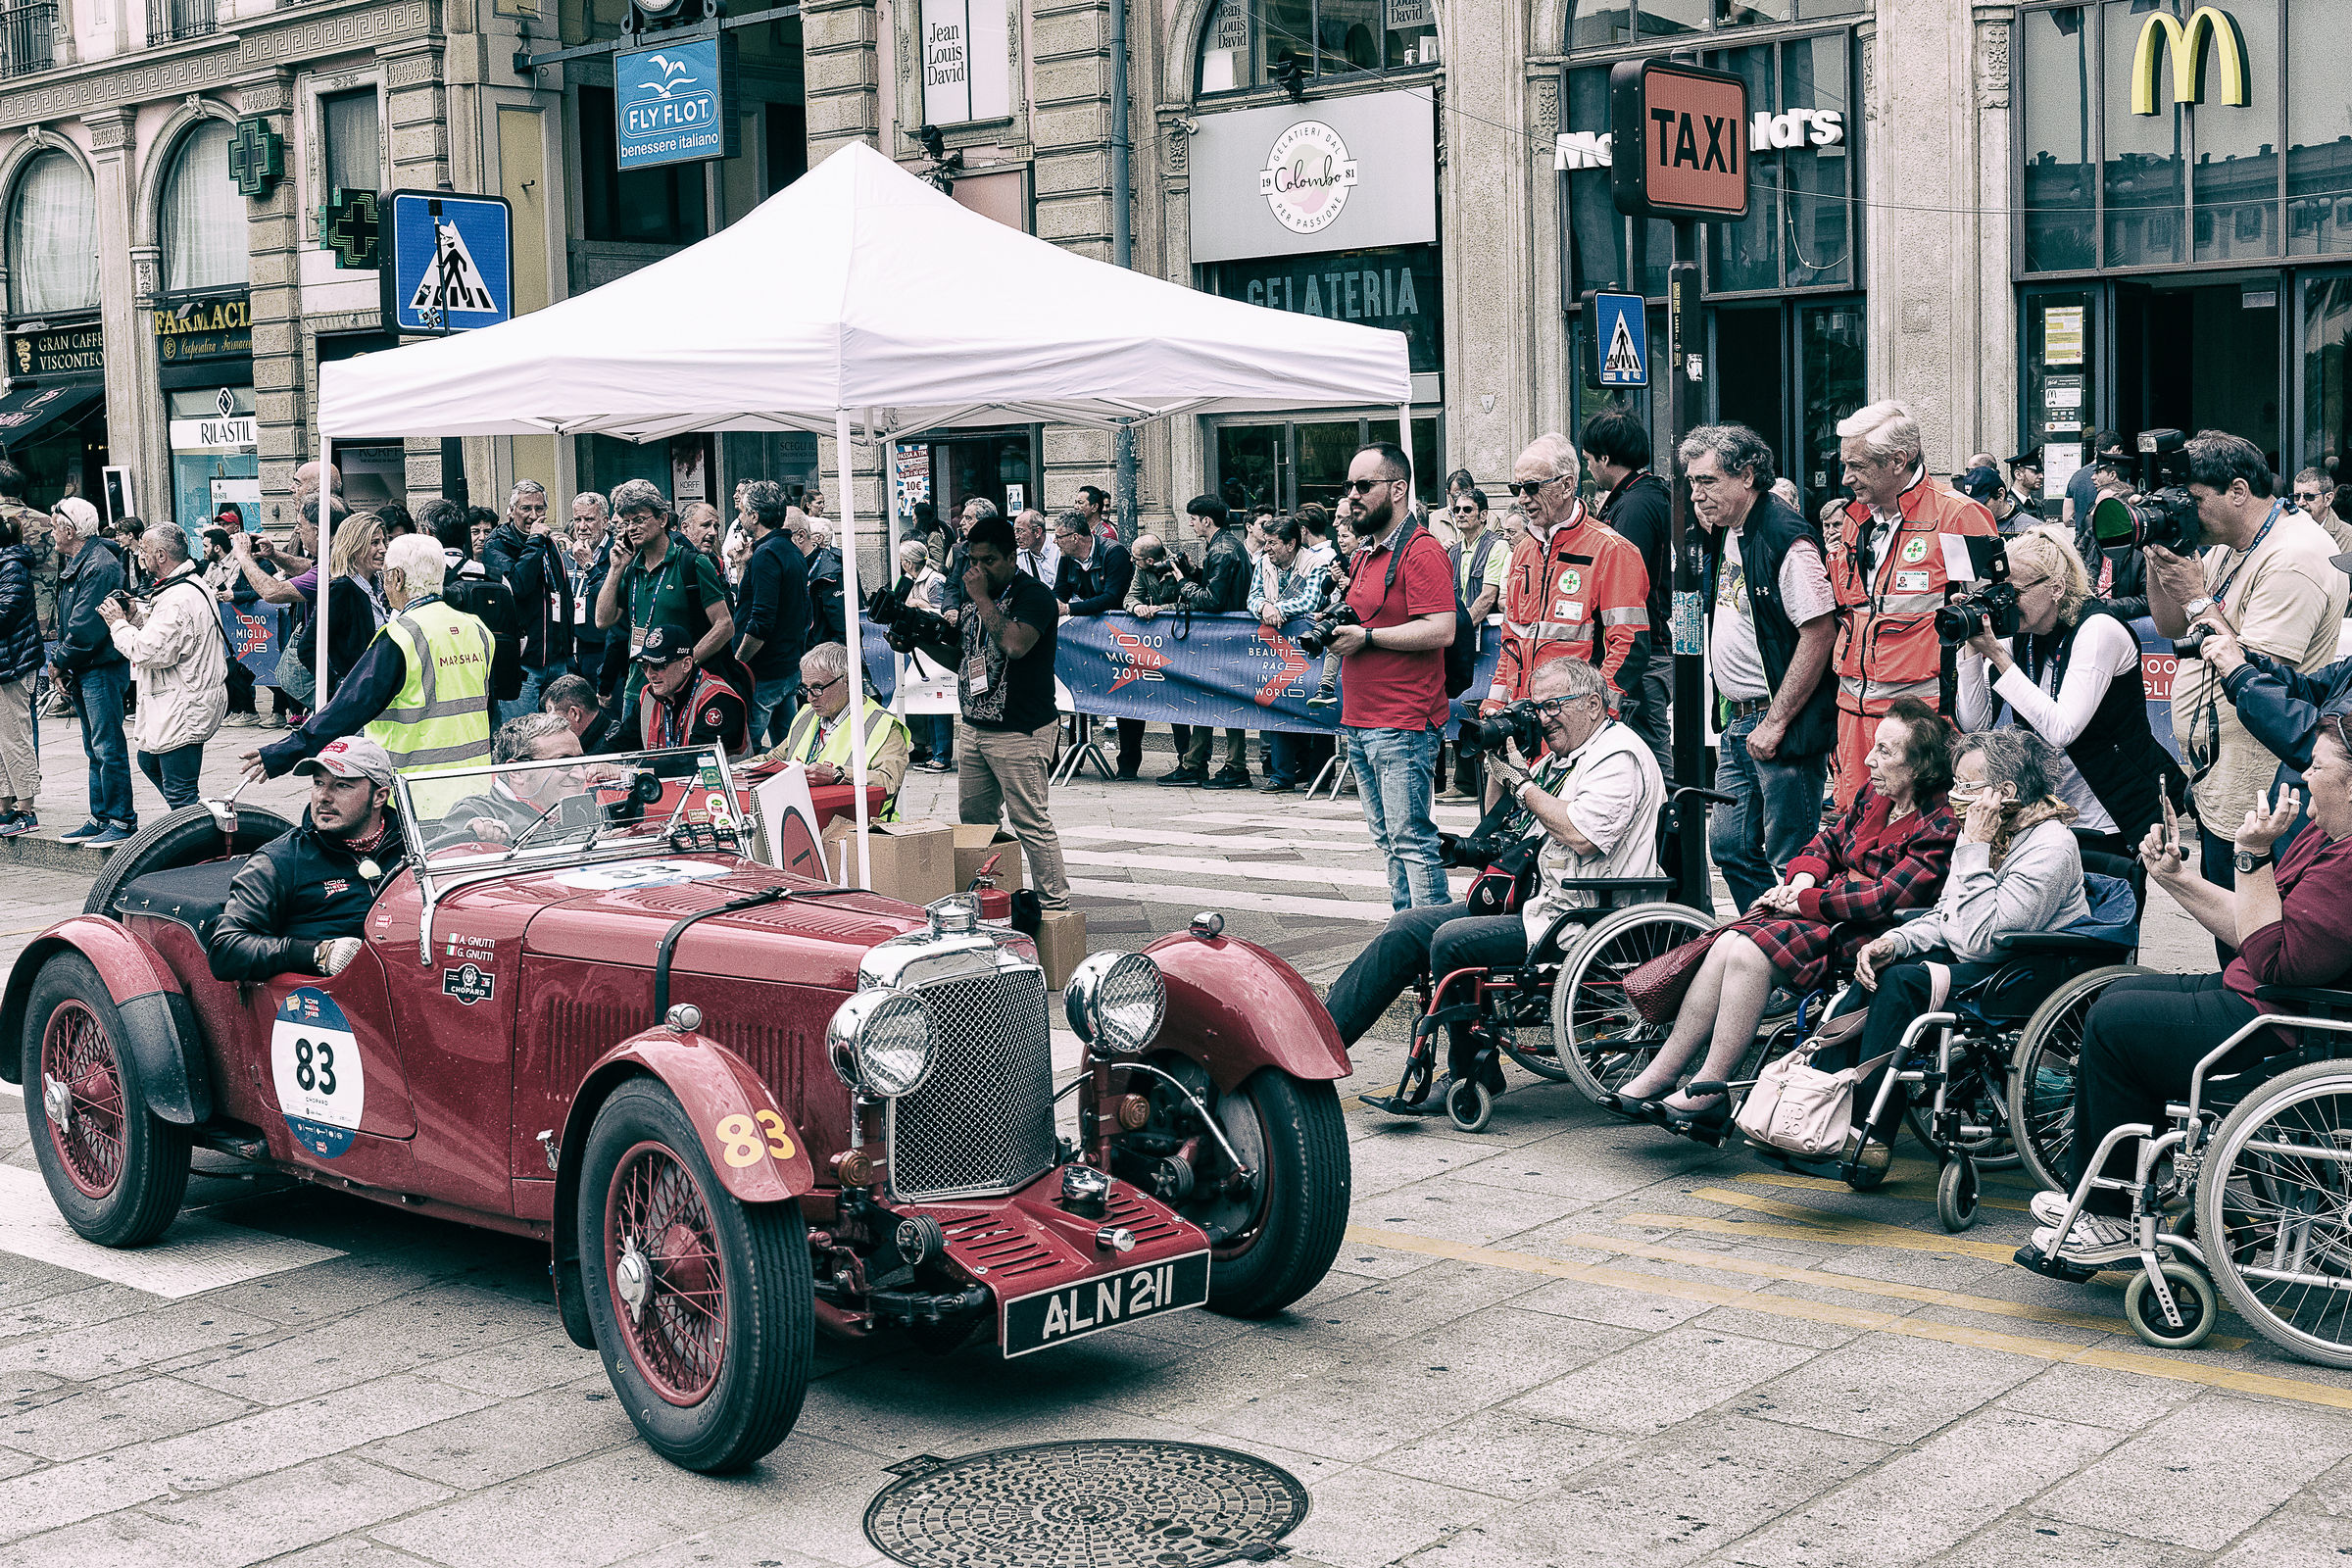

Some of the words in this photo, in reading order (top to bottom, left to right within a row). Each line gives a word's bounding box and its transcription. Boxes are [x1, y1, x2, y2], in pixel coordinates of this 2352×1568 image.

[1216, 3, 1240, 18] Jean
[1390, 5, 1423, 24] David
[929, 23, 959, 43] Jean
[1217, 17, 1247, 34] Louis
[1218, 31, 1247, 49] David
[928, 41, 962, 65] Louis
[927, 61, 965, 86] David
[629, 107, 660, 130] FLY
[620, 139, 677, 158] benessere
[678, 132, 718, 149] italiano
[1274, 127, 1321, 162] GELATIERI
[1325, 133, 1341, 155] DAL
[1650, 107, 1738, 174] TAXI
[1275, 154, 1342, 193] Colombo
[1345, 169, 1354, 178] 81
[1261, 177, 1271, 188] 19
[1277, 203, 1292, 222] PER
[1296, 196, 1342, 228] PASSIONE
[1247, 267, 1419, 318] GELATERIA
[39, 335, 70, 352] GRAN
[39, 351, 104, 370] VISCONTEO
[201, 420, 254, 445] RILASTIL
[780, 441, 807, 451] SCEGLI
[906, 481, 921, 490] 10€
[235, 614, 267, 625] 1000
[236, 628, 268, 639] MIGLIA
[1108, 633, 1163, 649] 1000
[1250, 634, 1283, 644] THE
[236, 642, 268, 653] 2018
[1248, 647, 1307, 658] BEAUTIF
[439, 652, 483, 667] MARSHAL
[1104, 651, 1161, 666] MIGLIA
[1261, 661, 1304, 671] RACE
[1111, 666, 1166, 681] 2018
[1256, 673, 1269, 683] IN
[1272, 674, 1304, 684] THE
[1254, 687, 1305, 698] WORLD
[323, 878, 346, 887] 1000
[459, 935, 466, 944] A.
[467, 936, 495, 949] GNUTTI
[457, 948, 465, 957] G.
[466, 949, 494, 961] GNUTTI
[451, 985, 485, 996] CHOPARD
[295, 1038, 337, 1096] 83
[715, 1108, 796, 1168] 83
[1042, 1277, 1122, 1340] ALN
[1129, 1264, 1173, 1315] 211
